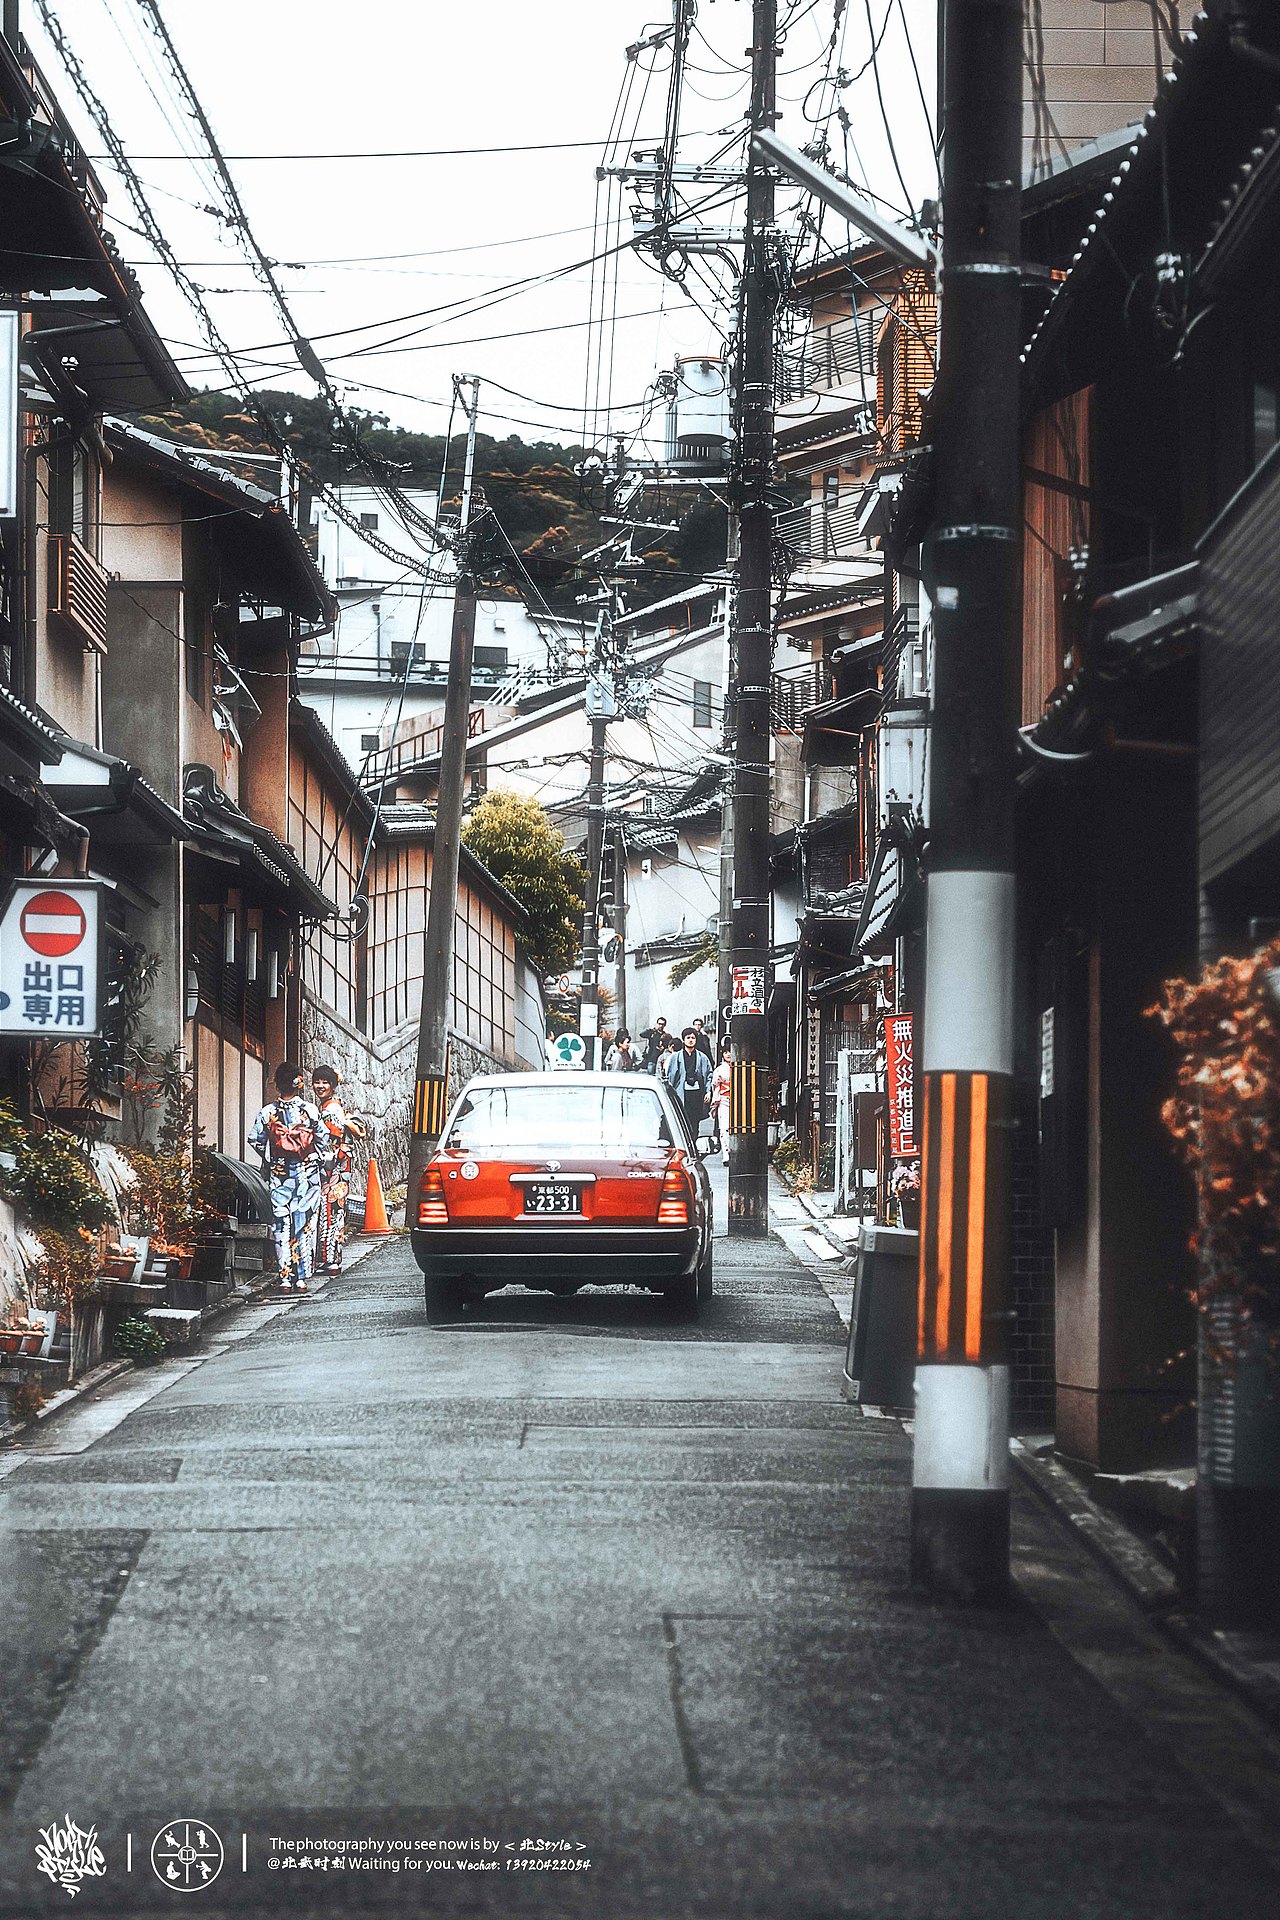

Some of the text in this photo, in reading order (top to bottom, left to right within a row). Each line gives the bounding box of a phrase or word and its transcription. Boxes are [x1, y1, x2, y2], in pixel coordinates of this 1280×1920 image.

[23, 960, 84, 992] 出口
[750, 967, 764, 1008] 杉立酒店
[22, 993, 85, 1026] 専用
[536, 1194, 577, 1211] 23-31
